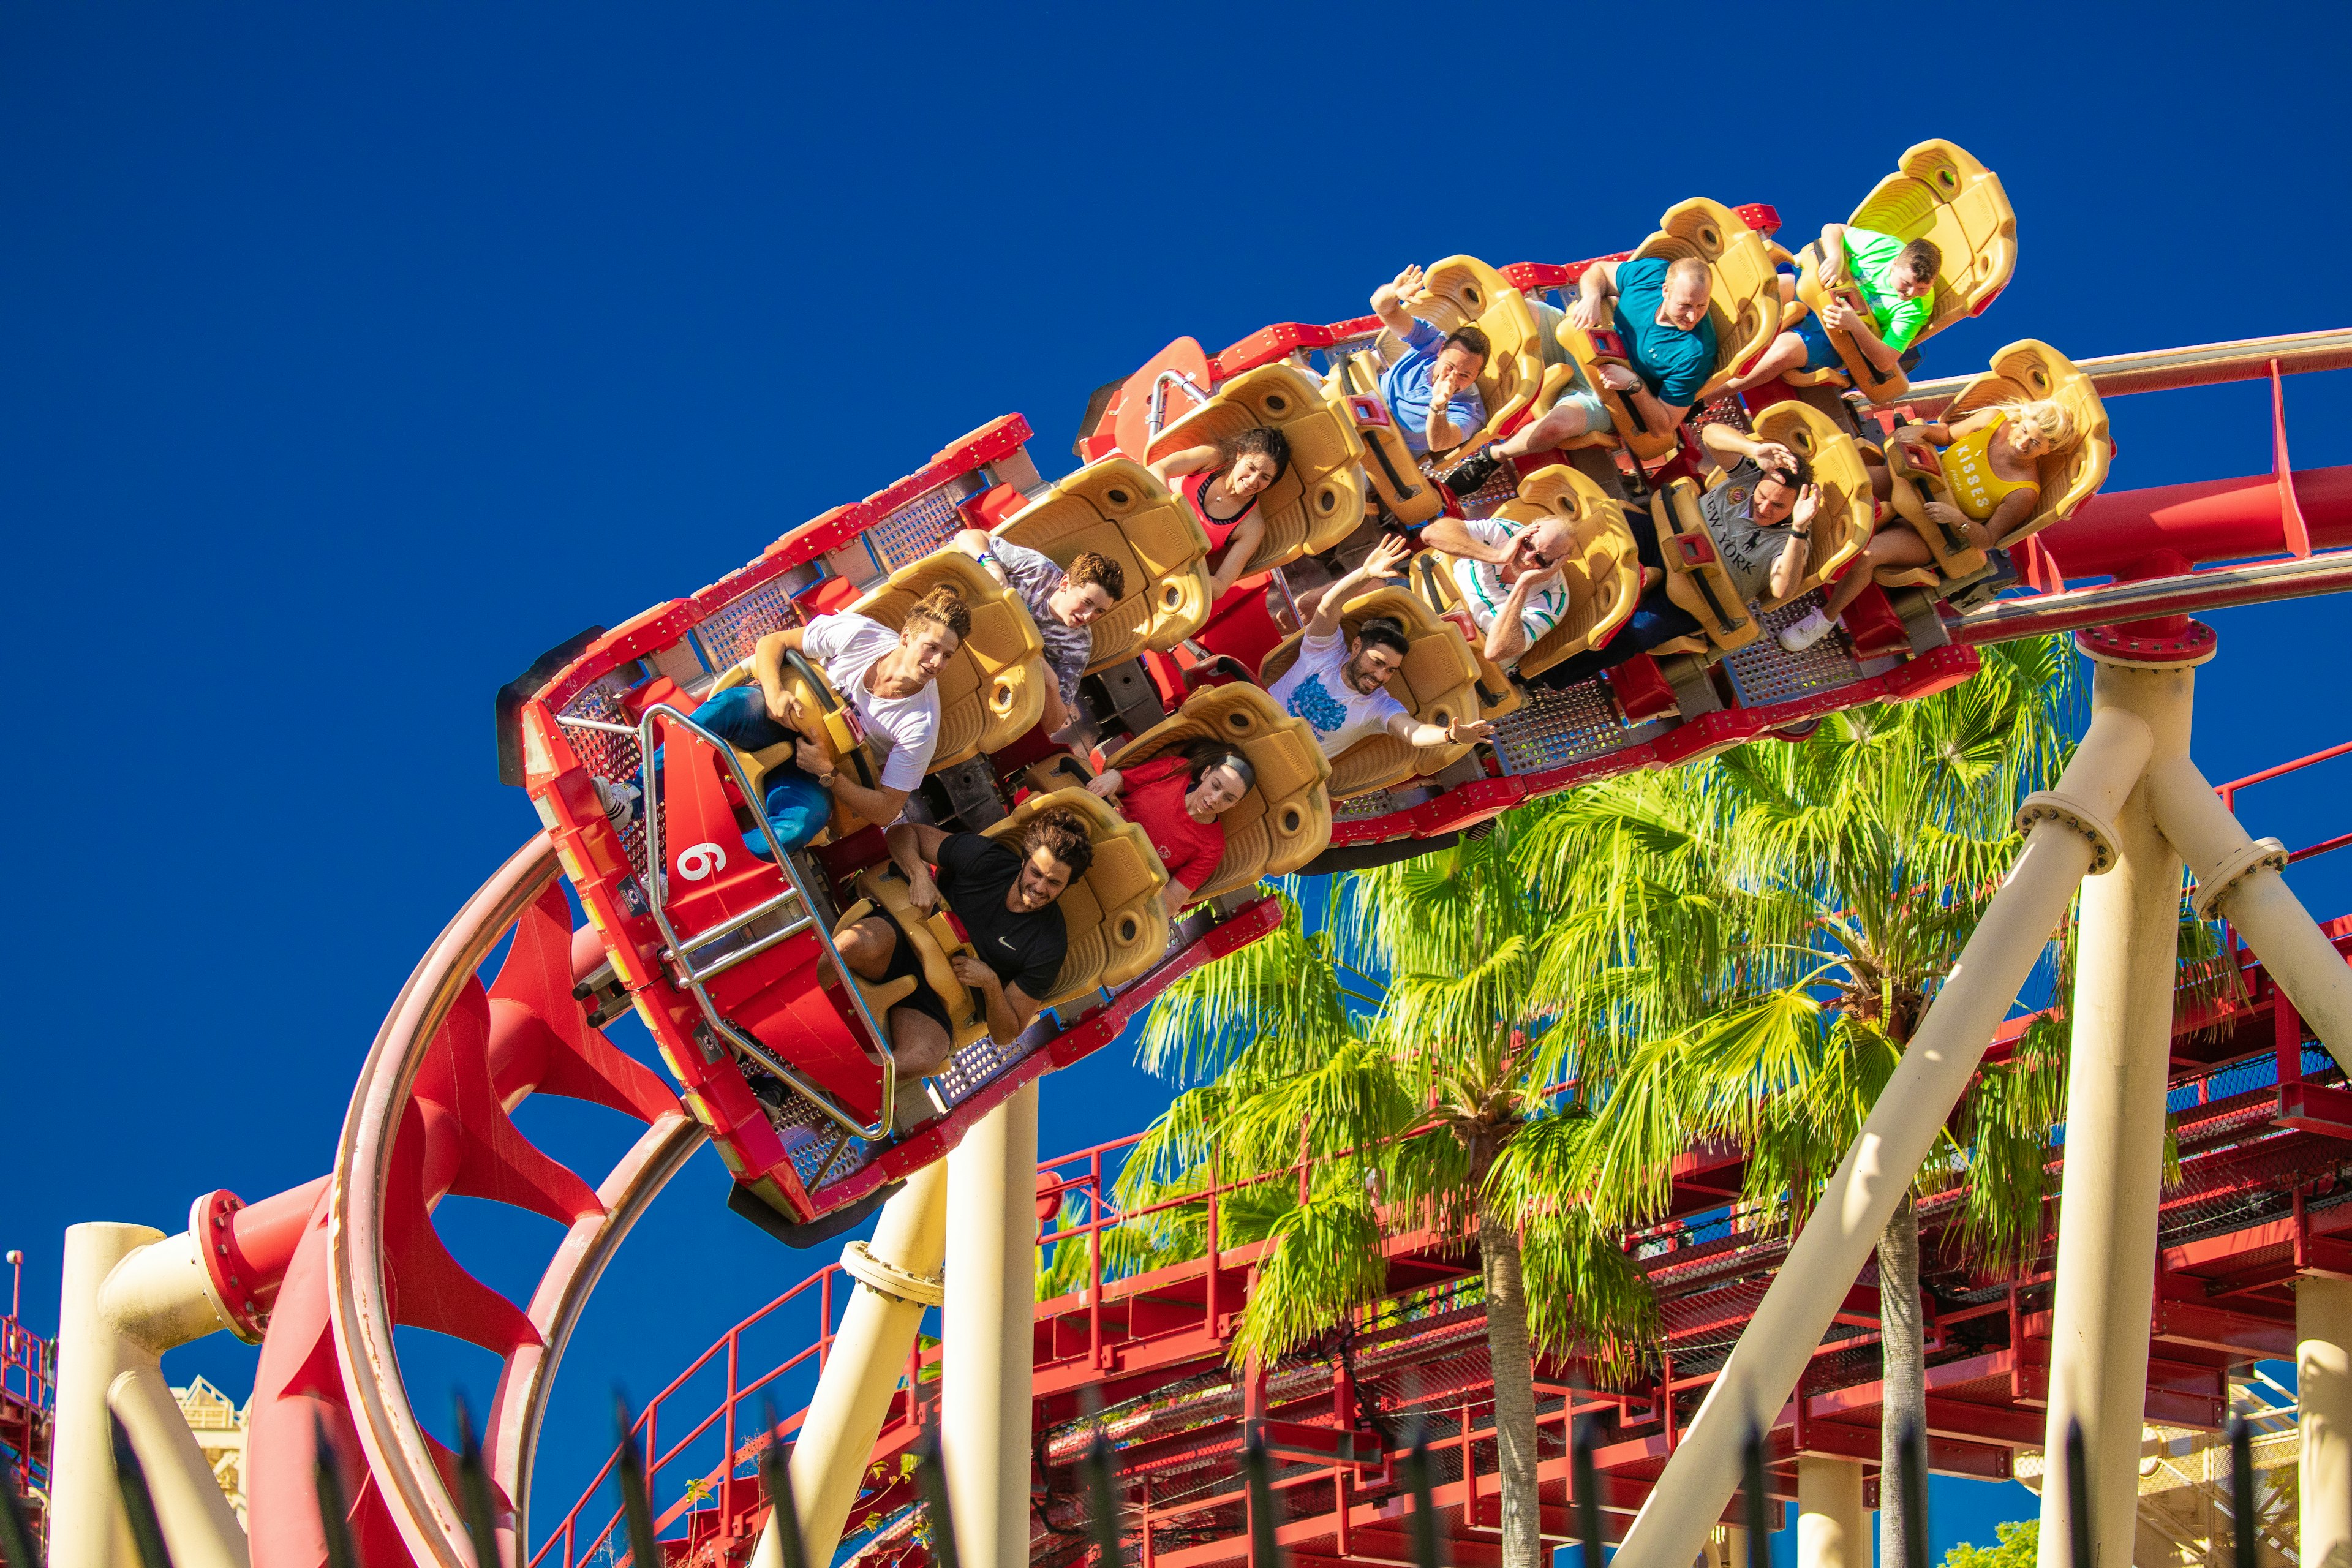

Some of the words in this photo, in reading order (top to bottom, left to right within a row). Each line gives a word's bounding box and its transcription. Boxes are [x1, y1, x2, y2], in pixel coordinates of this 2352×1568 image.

[1950, 469, 1962, 492] FROM
[1956, 444, 1990, 508] KISSES
[1706, 489, 1723, 527] NEW
[1718, 531, 1757, 575] YORK
[677, 842, 727, 881] 6
[619, 889, 634, 913] WARNING
